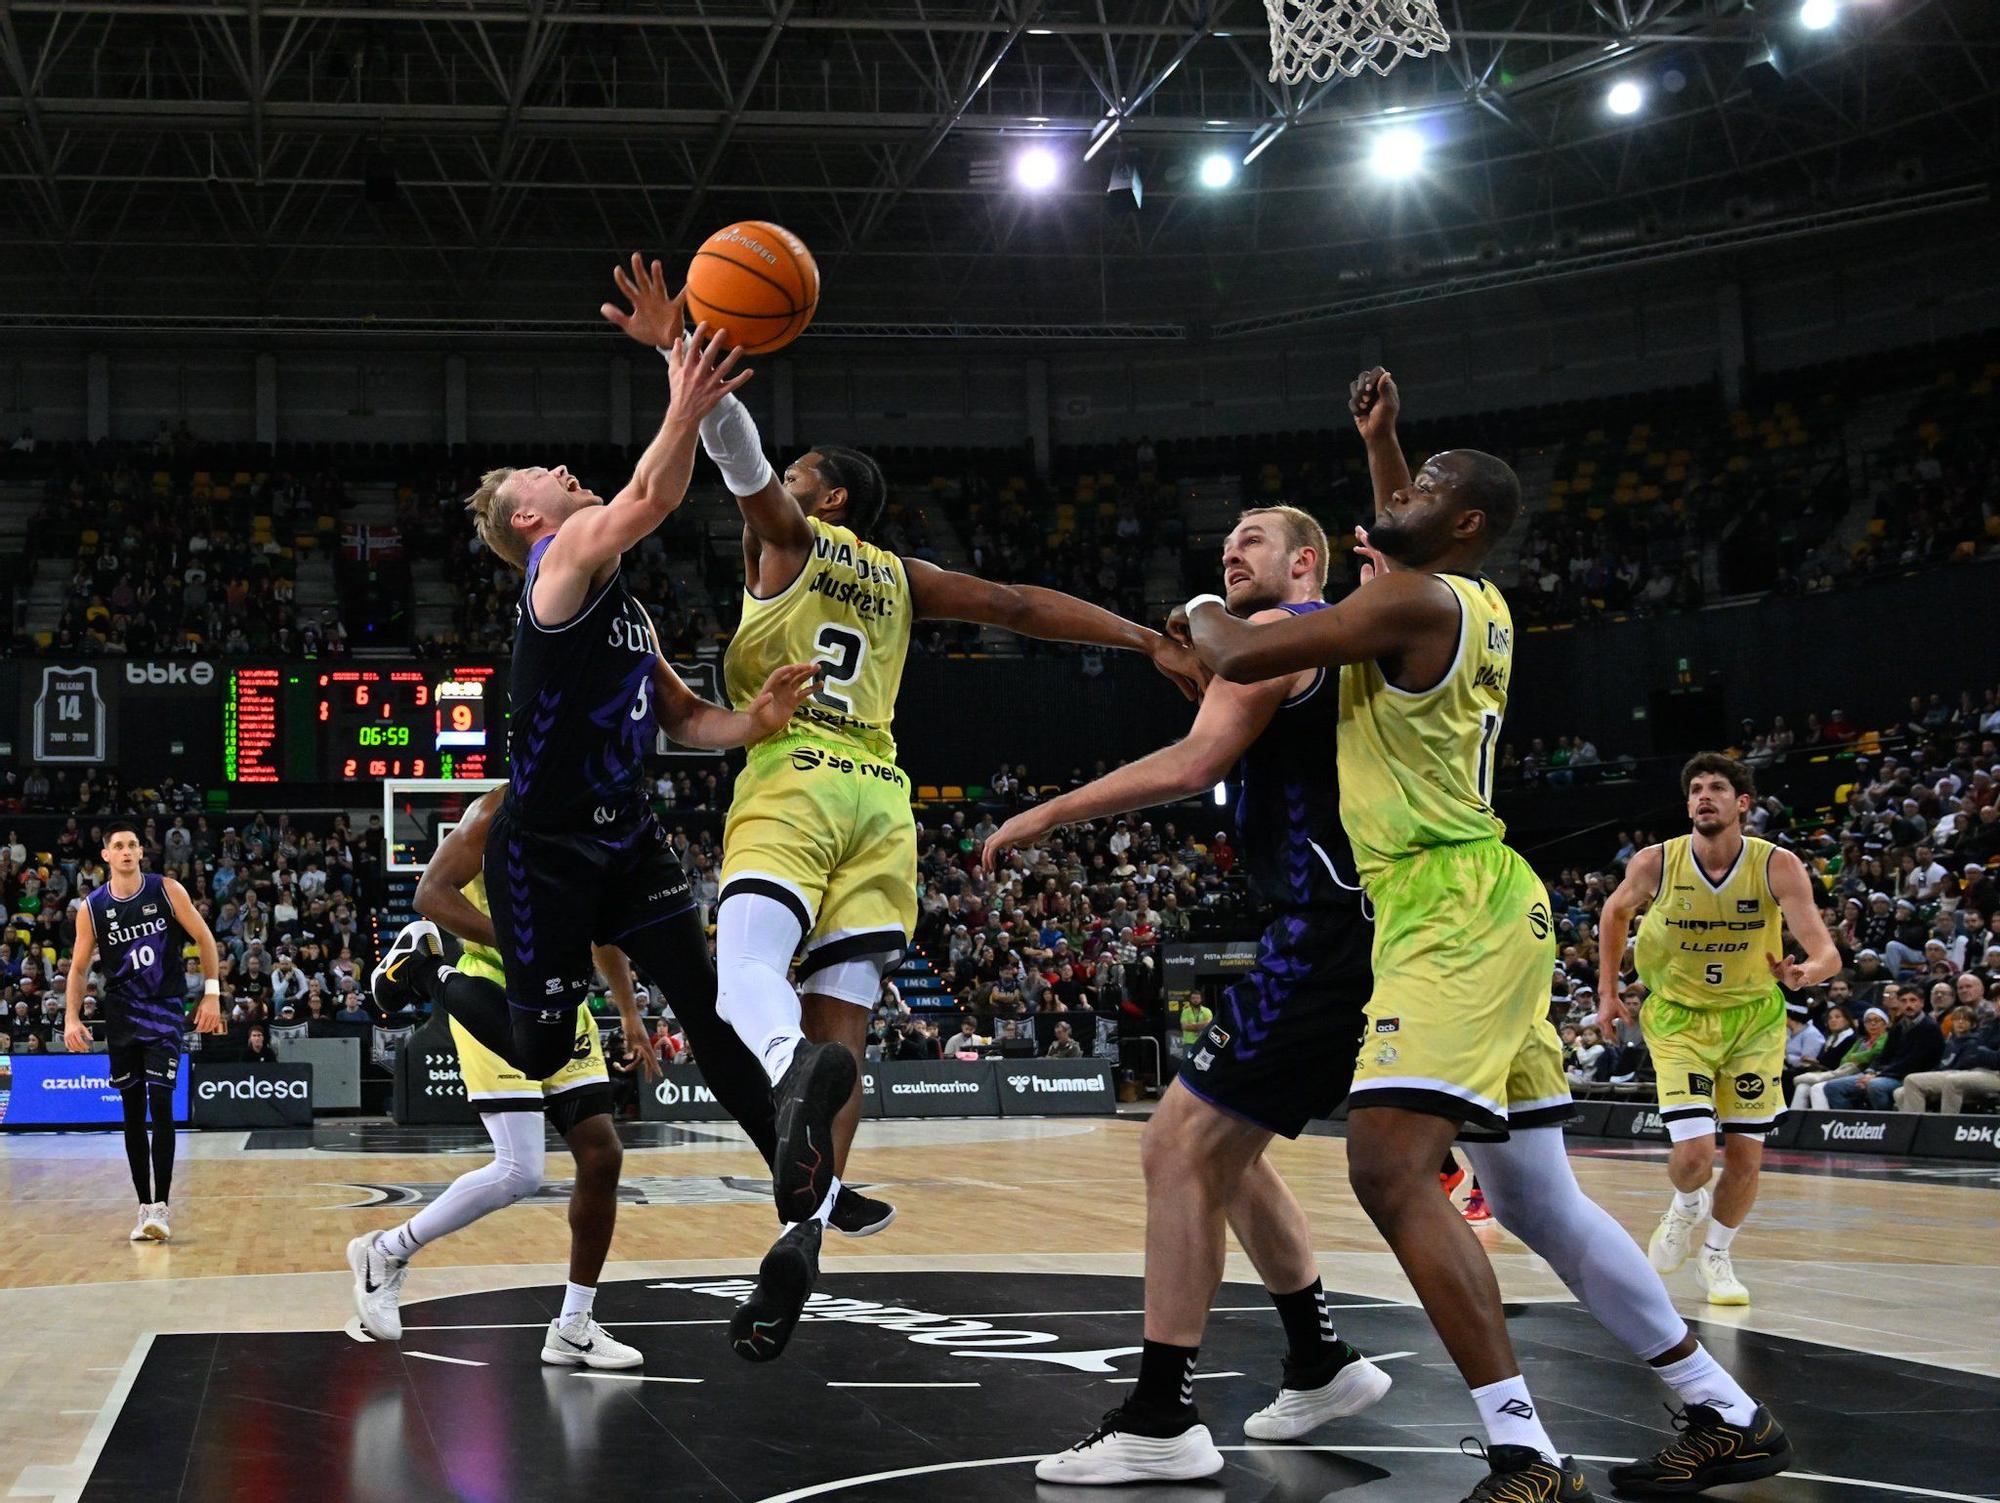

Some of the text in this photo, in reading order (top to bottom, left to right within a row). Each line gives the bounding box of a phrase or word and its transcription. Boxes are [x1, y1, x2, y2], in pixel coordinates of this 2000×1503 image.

[815, 536, 895, 585] WADEN
[608, 617, 655, 655] sur
[126, 663, 187, 684] bbk
[811, 623, 866, 714] 2
[356, 685, 369, 705] 6
[416, 685, 428, 705] 3
[57, 695, 82, 721] 14
[452, 704, 472, 731] 9
[359, 727, 409, 746] 06:59
[344, 760, 357, 776] 2
[413, 760, 424, 776] 3
[648, 883, 689, 901] NISSAN
[107, 917, 168, 946] surne
[1680, 942, 1749, 952] LLEIDA
[129, 945, 155, 970] 10
[1165, 955, 1195, 965] vueling
[904, 978, 928, 988] IMQ
[1705, 963, 1723, 985] 5
[916, 997, 941, 1006] IMQ
[1377, 1024, 1396, 1032] acb
[429, 1069, 458, 1080] bbk
[1032, 1074, 1105, 1092] hummel
[199, 1075, 308, 1099] endesa
[681, 1085, 717, 1102] IM
[891, 1080, 979, 1094] azulmarino
[1736, 1080, 1763, 1093] Q2
[1832, 1121, 1886, 1140] Occident
[1954, 1125, 1993, 1142] bbk
